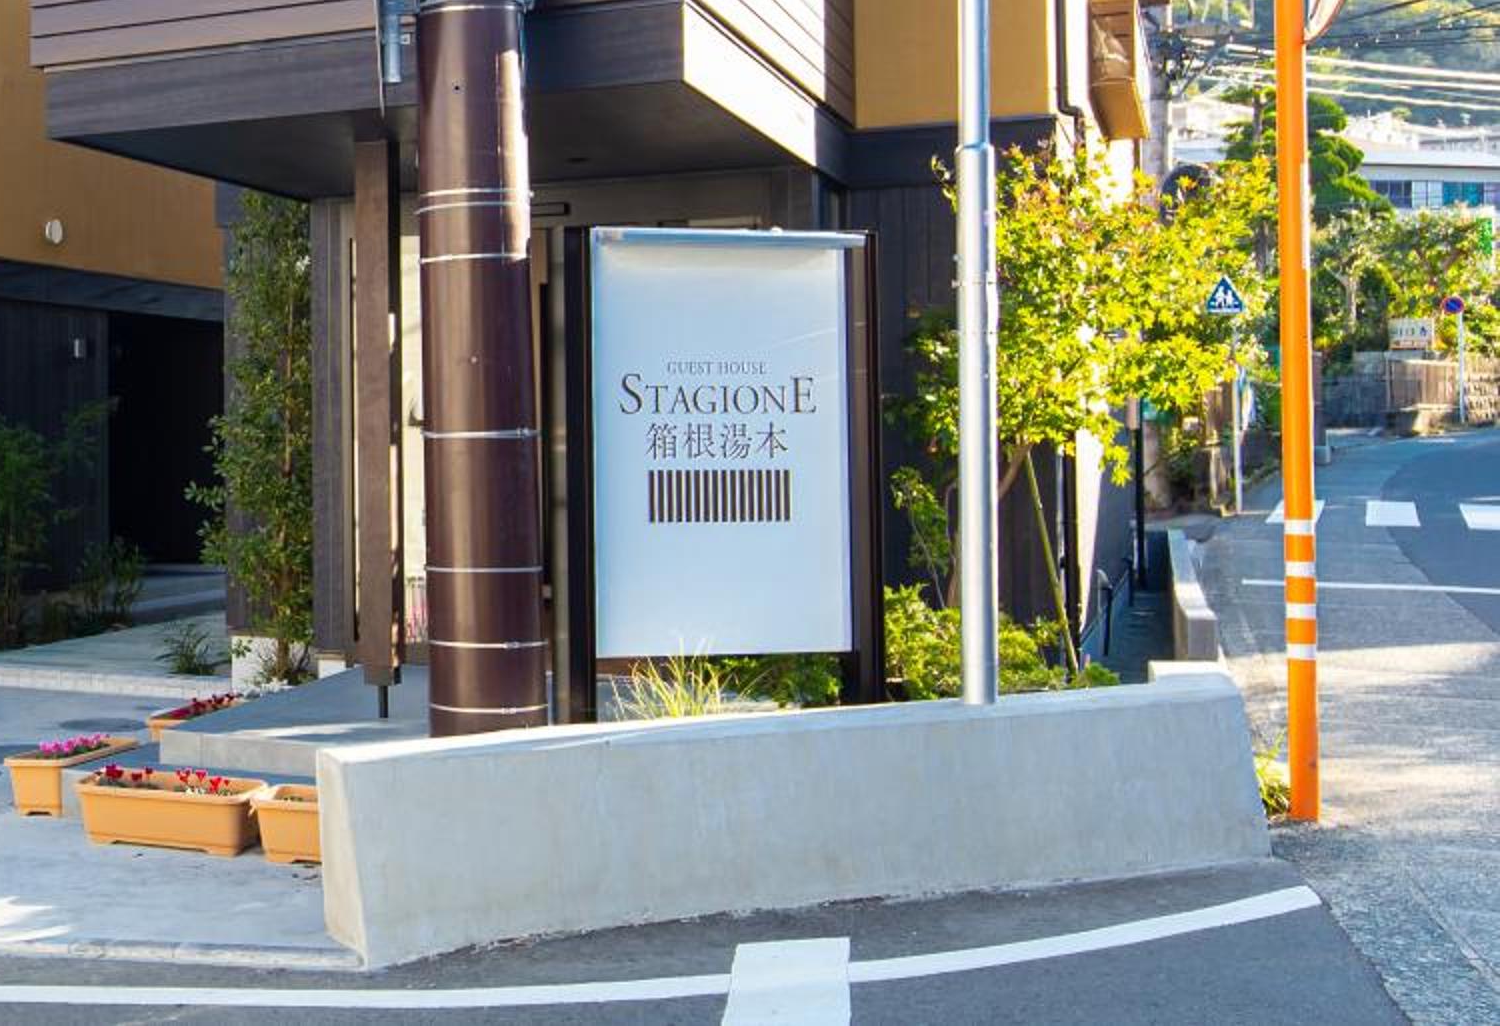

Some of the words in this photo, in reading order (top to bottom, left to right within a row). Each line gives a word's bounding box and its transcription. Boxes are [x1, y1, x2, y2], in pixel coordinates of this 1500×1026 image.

[667, 361, 713, 375] GUEST
[718, 361, 766, 375] HOUSE
[619, 373, 817, 415] STAGIONE
[645, 421, 789, 460] 箱根湯本
